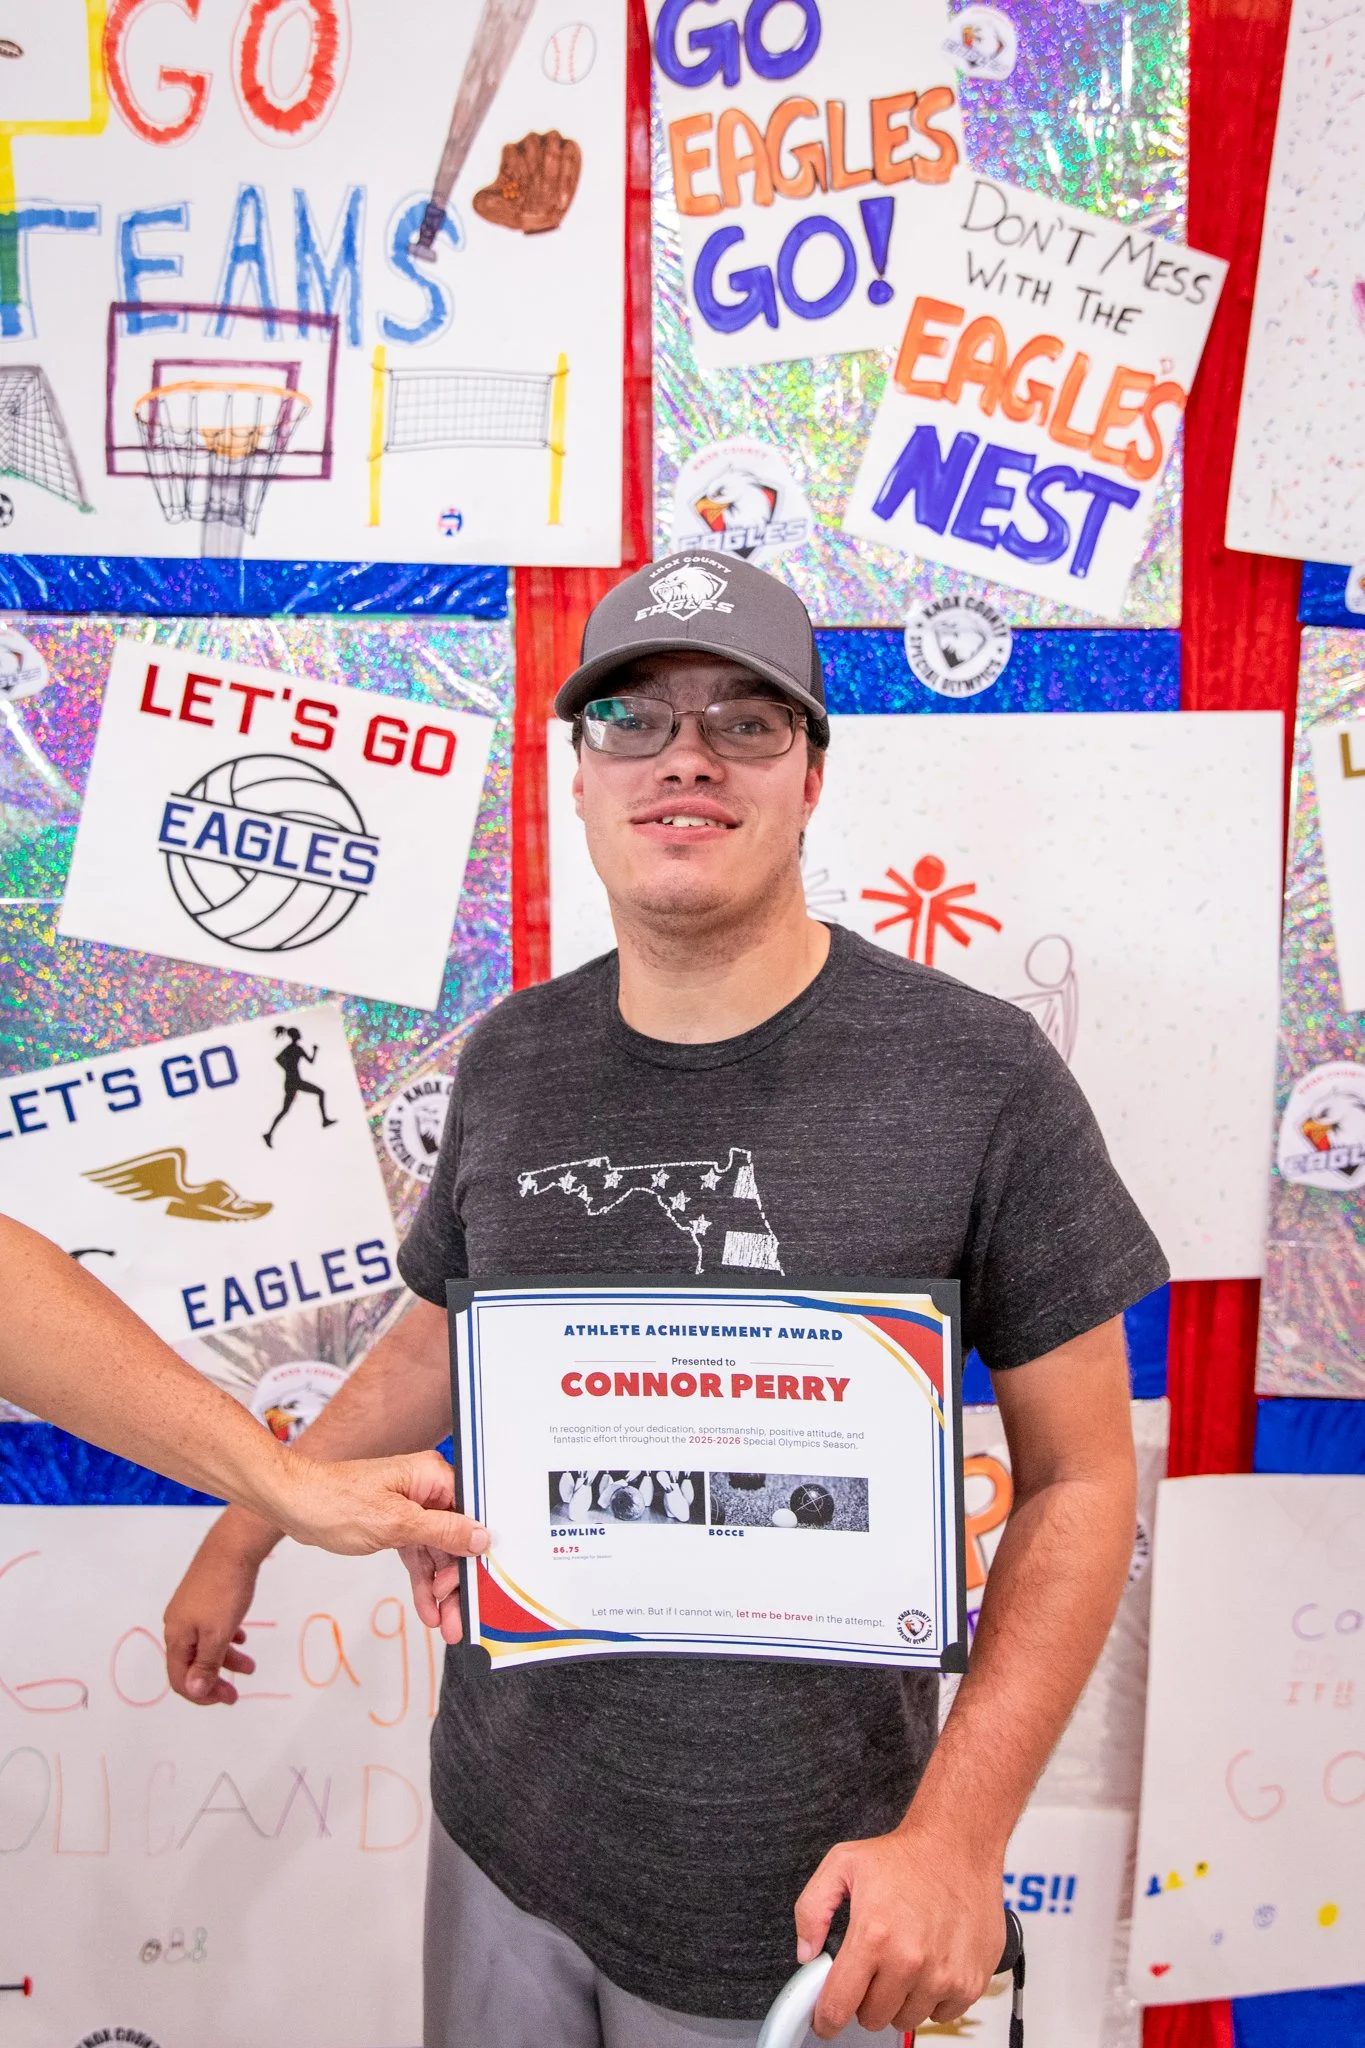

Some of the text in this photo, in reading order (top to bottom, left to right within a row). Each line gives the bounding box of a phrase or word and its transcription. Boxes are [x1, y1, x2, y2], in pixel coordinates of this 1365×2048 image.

[103, 0, 349, 147] GO
[655, 0, 821, 88] GO
[668, 86, 959, 217] EAGLES
[0, 183, 466, 348] TEAMS
[693, 196, 895, 334] GO!
[961, 180, 1213, 305] DON'T MESS
[967, 250, 1144, 336] WITH THE
[678, 518, 808, 552] EAGLES
[871, 425, 1141, 580] NEST
[649, 556, 732, 578] KNOX COUNTY
[634, 599, 735, 622] EAGLES
[139, 663, 458, 778] LET'S GO
[157, 800, 380, 886] EAGLES
[0, 1045, 239, 1140] ET'S GO
[181, 1239, 392, 1330] EAGLES
[563, 1324, 843, 1341] ATHLETE ACHIEVEMENT AWARD
[671, 1357, 736, 1367] Presented to
[560, 1371, 851, 1402] CONNOR PERRY
[549, 1425, 865, 1440] In recognition of your dedication, sportsmanship, positive attitude, and
[553, 1434, 860, 1450] fantastic effort throughout the 2025-2026 Special Olympics Season.
[550, 1528, 745, 1537] BOWLING BOCCE
[553, 1546, 580, 1554] 86.75
[592, 1608, 607, 1617] Let
[609, 1608, 624, 1616] me
[626, 1606, 645, 1615] win.
[648, 1606, 664, 1616] But
[666, 1606, 672, 1616] if
[680, 1607, 712, 1617] cannot
[714, 1609, 735, 1619] win,
[736, 1609, 749, 1618] let
[752, 1610, 767, 1619] me
[769, 1611, 782, 1620] be
[784, 1612, 813, 1622] brave
[815, 1613, 825, 1622] in
[827, 1615, 843, 1624] the
[845, 1617, 886, 1628] attempt.
